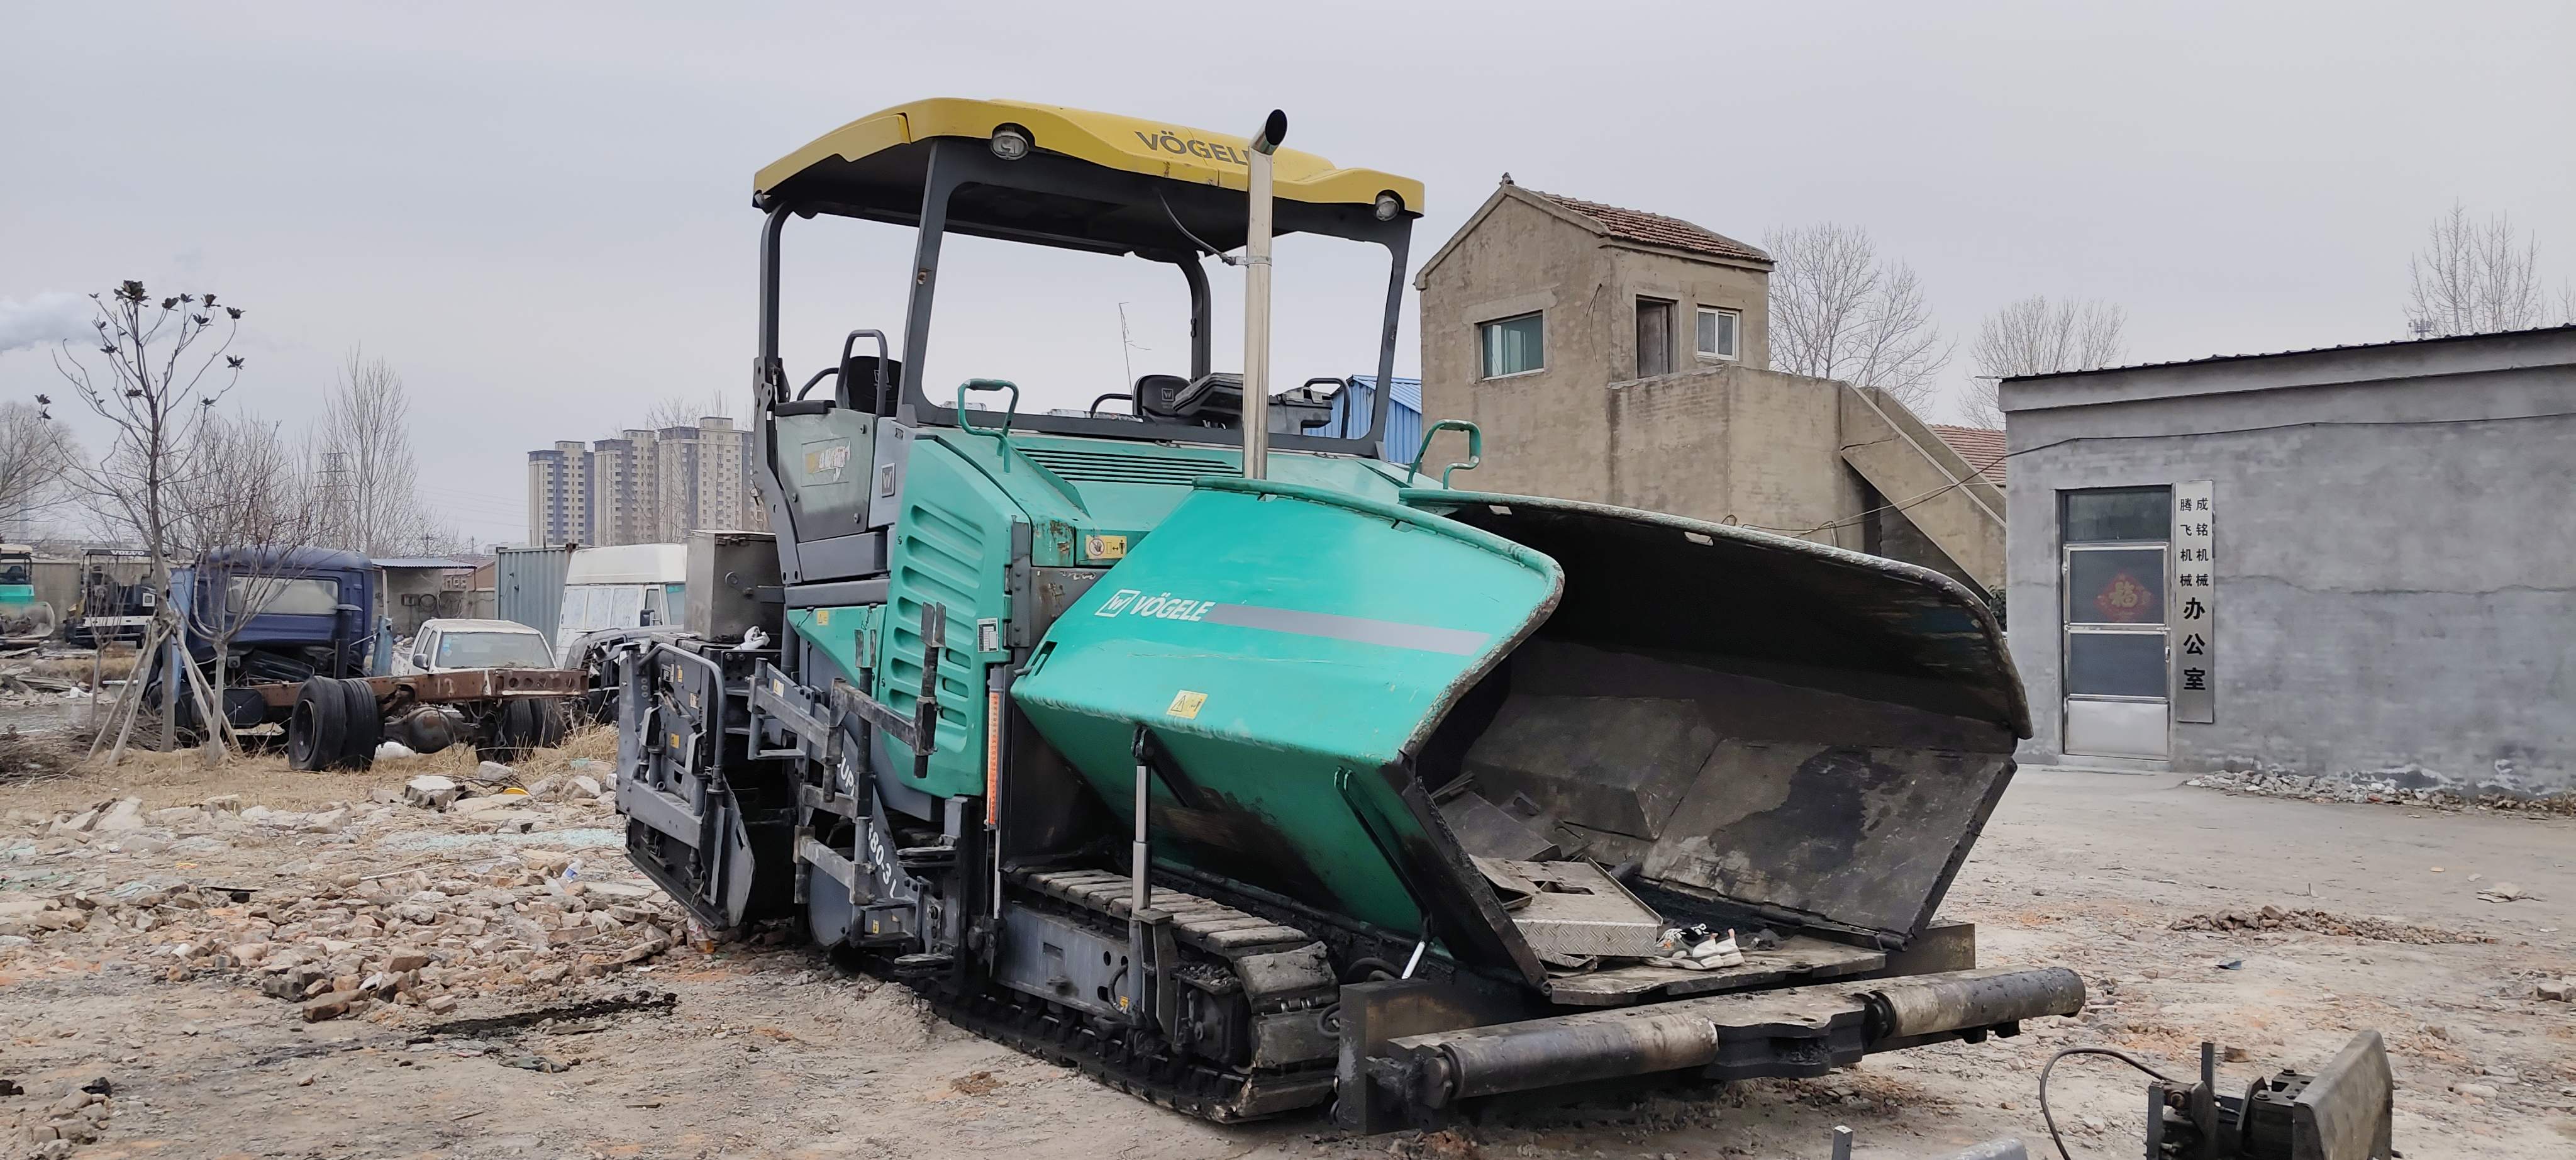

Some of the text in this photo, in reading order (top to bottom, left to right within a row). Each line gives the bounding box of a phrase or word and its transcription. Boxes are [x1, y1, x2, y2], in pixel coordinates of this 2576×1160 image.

[1134, 130, 1248, 166] VÖGEL
[2180, 498, 2193, 588] 腾飞机械
[2196, 498, 2209, 587] 成铭机械
[1130, 592, 1217, 622] VÖGELE
[2183, 597, 2206, 691] 办公室
